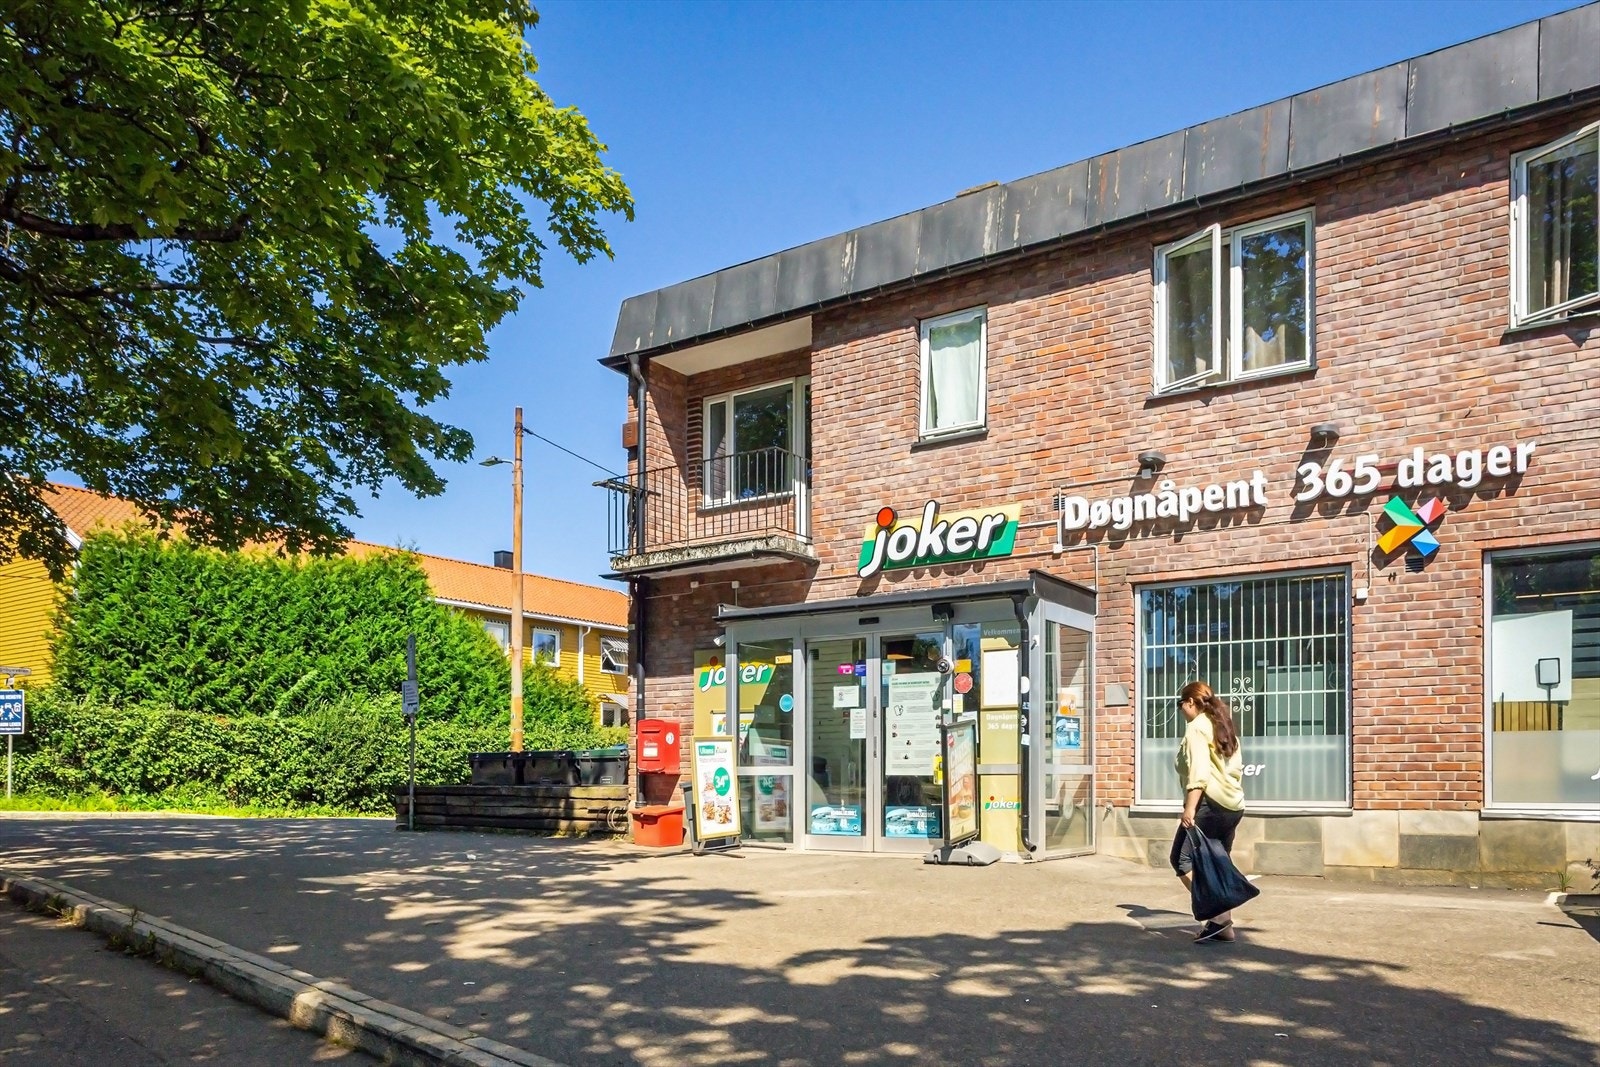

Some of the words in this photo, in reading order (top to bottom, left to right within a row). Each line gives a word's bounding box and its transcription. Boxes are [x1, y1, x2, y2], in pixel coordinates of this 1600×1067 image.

[1064, 469, 1268, 531] Døgnåpent
[1297, 454, 1381, 502] 365
[1397, 440, 1537, 489] dager
[858, 500, 1007, 578] joker
[702, 656, 769, 692] joer
[718, 717, 752, 733] jer
[986, 796, 1019, 812] joker
